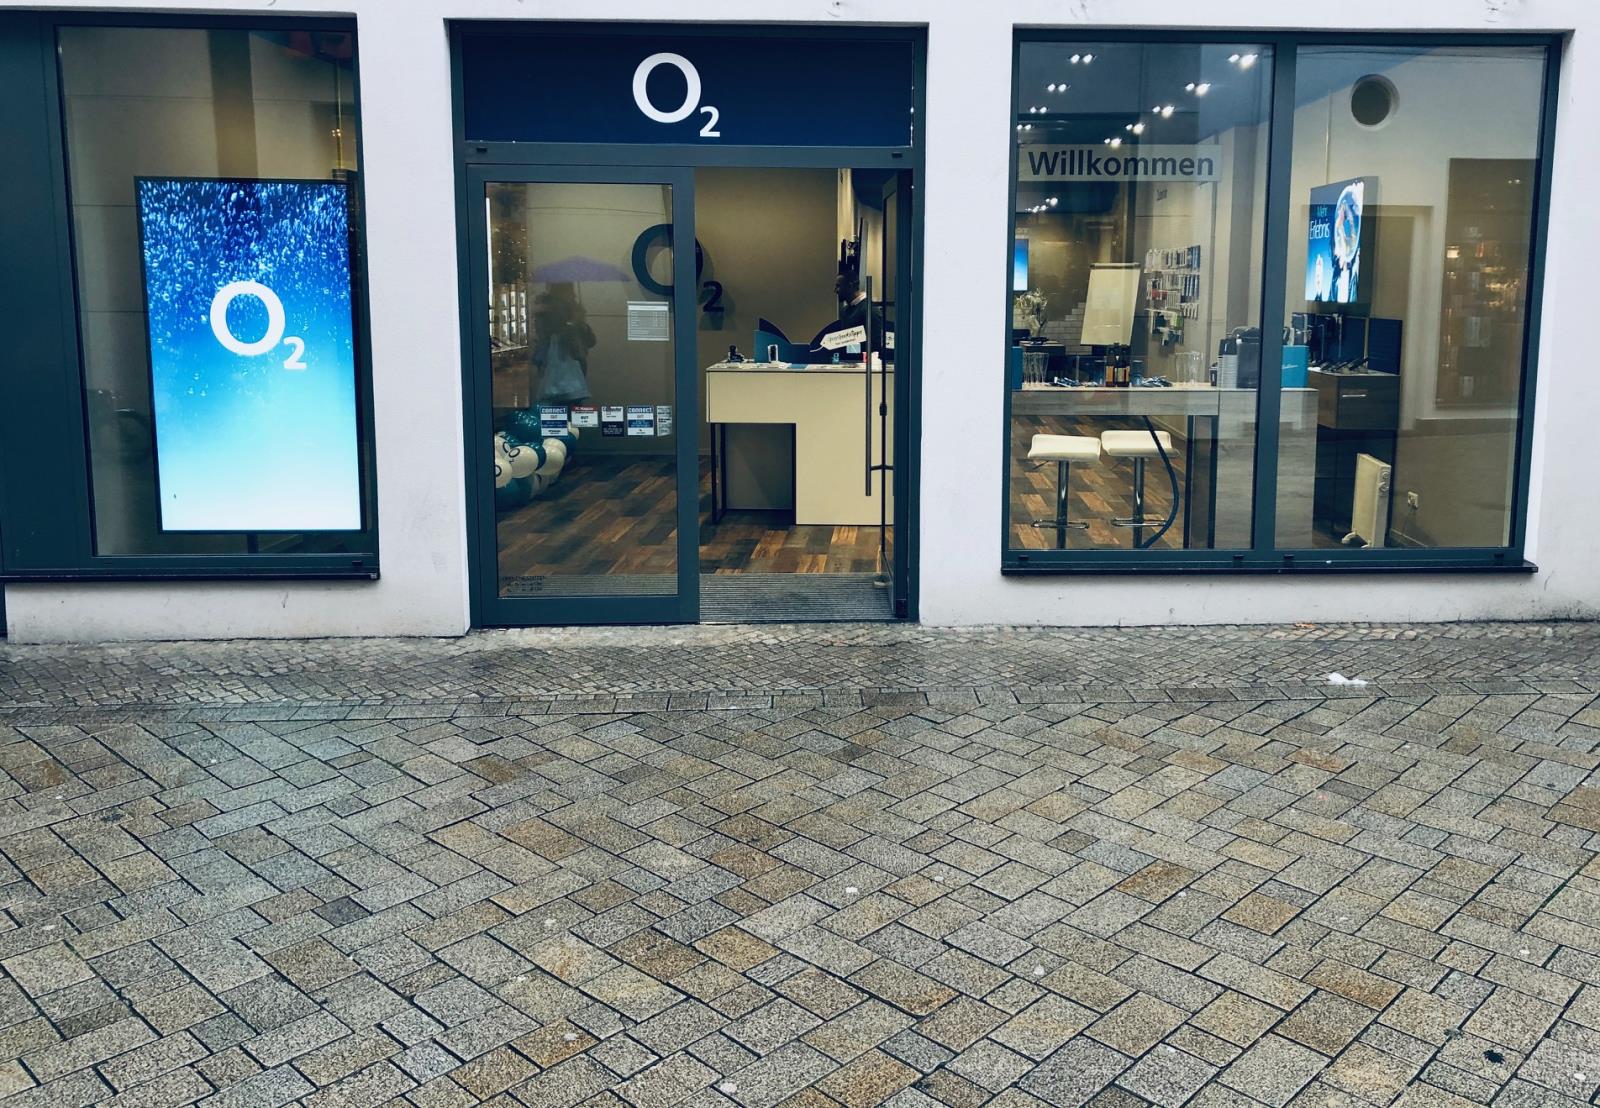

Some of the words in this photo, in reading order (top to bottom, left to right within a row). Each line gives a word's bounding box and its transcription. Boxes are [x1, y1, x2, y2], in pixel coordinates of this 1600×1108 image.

[632, 52, 721, 138] O2
[1028, 149, 1214, 176] Willkommen
[1309, 218, 1331, 240] Erlebnis
[209, 279, 307, 370] O2
